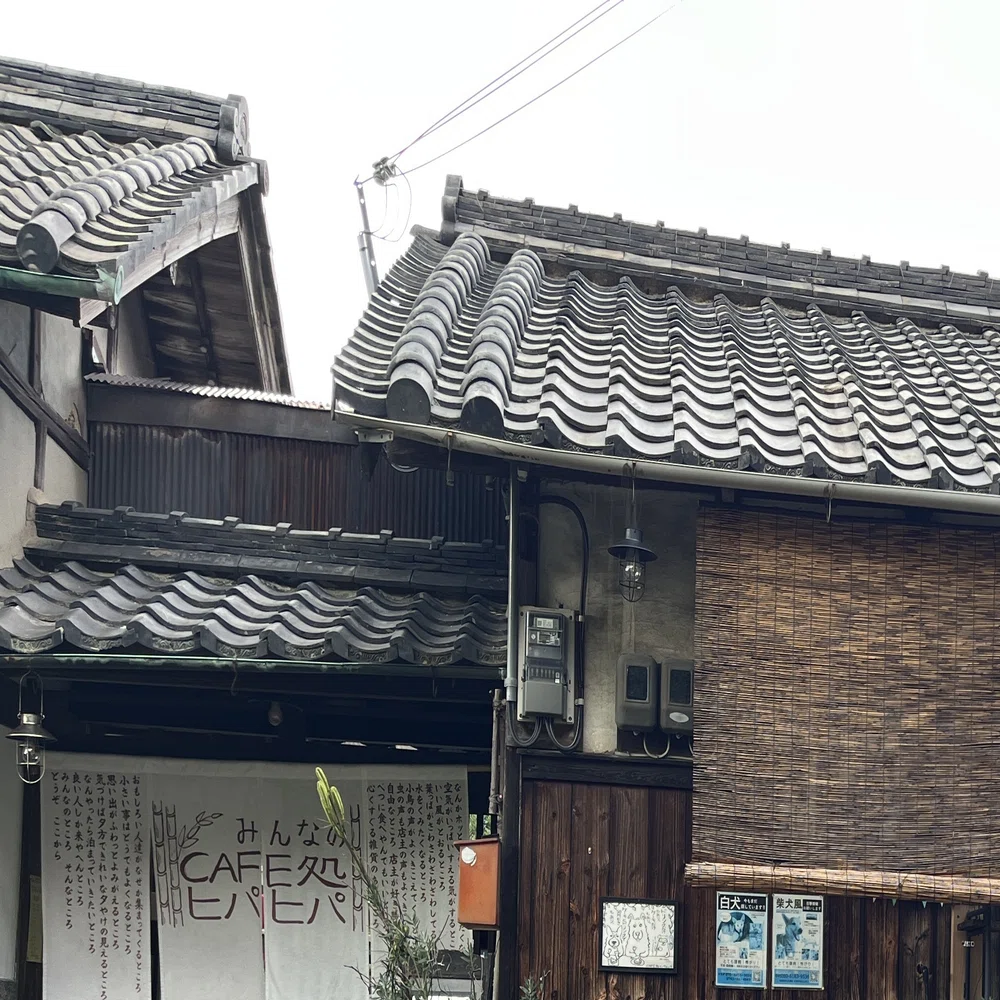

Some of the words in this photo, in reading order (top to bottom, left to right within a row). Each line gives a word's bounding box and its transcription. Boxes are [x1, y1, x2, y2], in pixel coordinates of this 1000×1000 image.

[53, 817, 62, 860] ここから
[61, 772, 71, 851] みんなのところ
[236, 818, 344, 847] みんなの
[386, 783, 396, 846] 自由なところ
[415, 784, 427, 902] 水をくみたくなるところ
[435, 784, 445, 891] いい風がとおるところ
[84, 774, 95, 953] なんやったら泊まっていきたいところ
[107, 774, 119, 950] 思い出がふわっとよみがえるところ
[180, 851, 348, 888] CAFE処
[65, 864, 73, 929] そんなところ
[188, 886, 346, 924] ヒパヒパ
[720, 896, 741, 910] 白犬
[776, 897, 802, 909] 柴犬風
